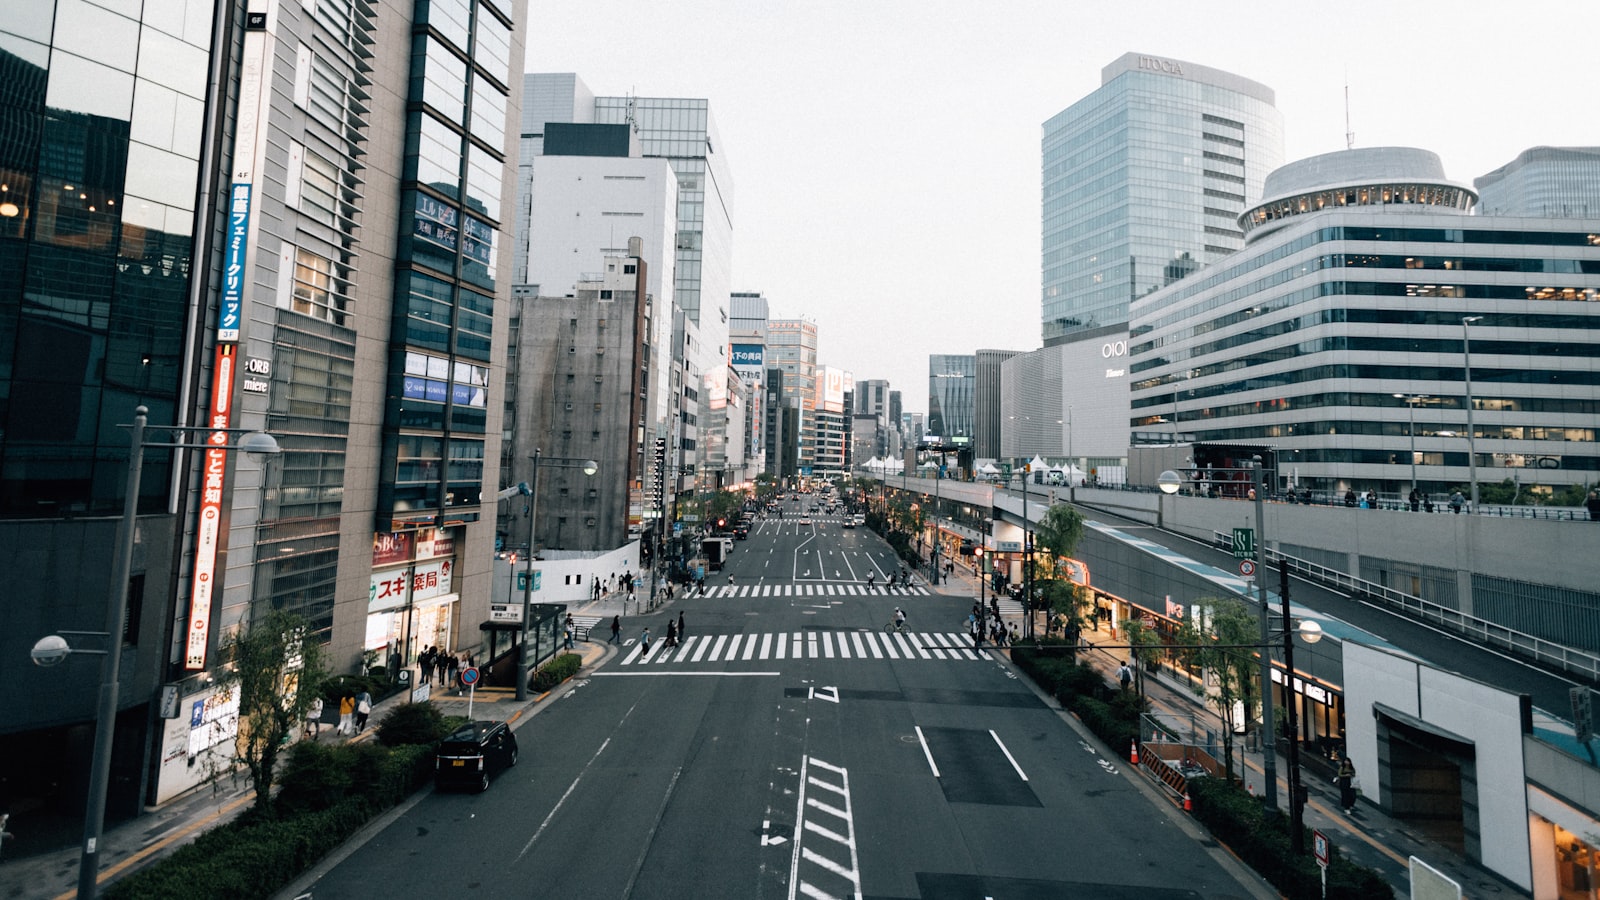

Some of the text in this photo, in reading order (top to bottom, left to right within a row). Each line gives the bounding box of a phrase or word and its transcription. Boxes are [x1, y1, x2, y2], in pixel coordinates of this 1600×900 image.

[251, 16, 263, 24] 6F
[223, 185, 249, 328] 銀座フェミークリニック
[250, 359, 270, 374] ORB
[204, 415, 227, 504] まるごと高知
[378, 570, 437, 599] スギ薬局
